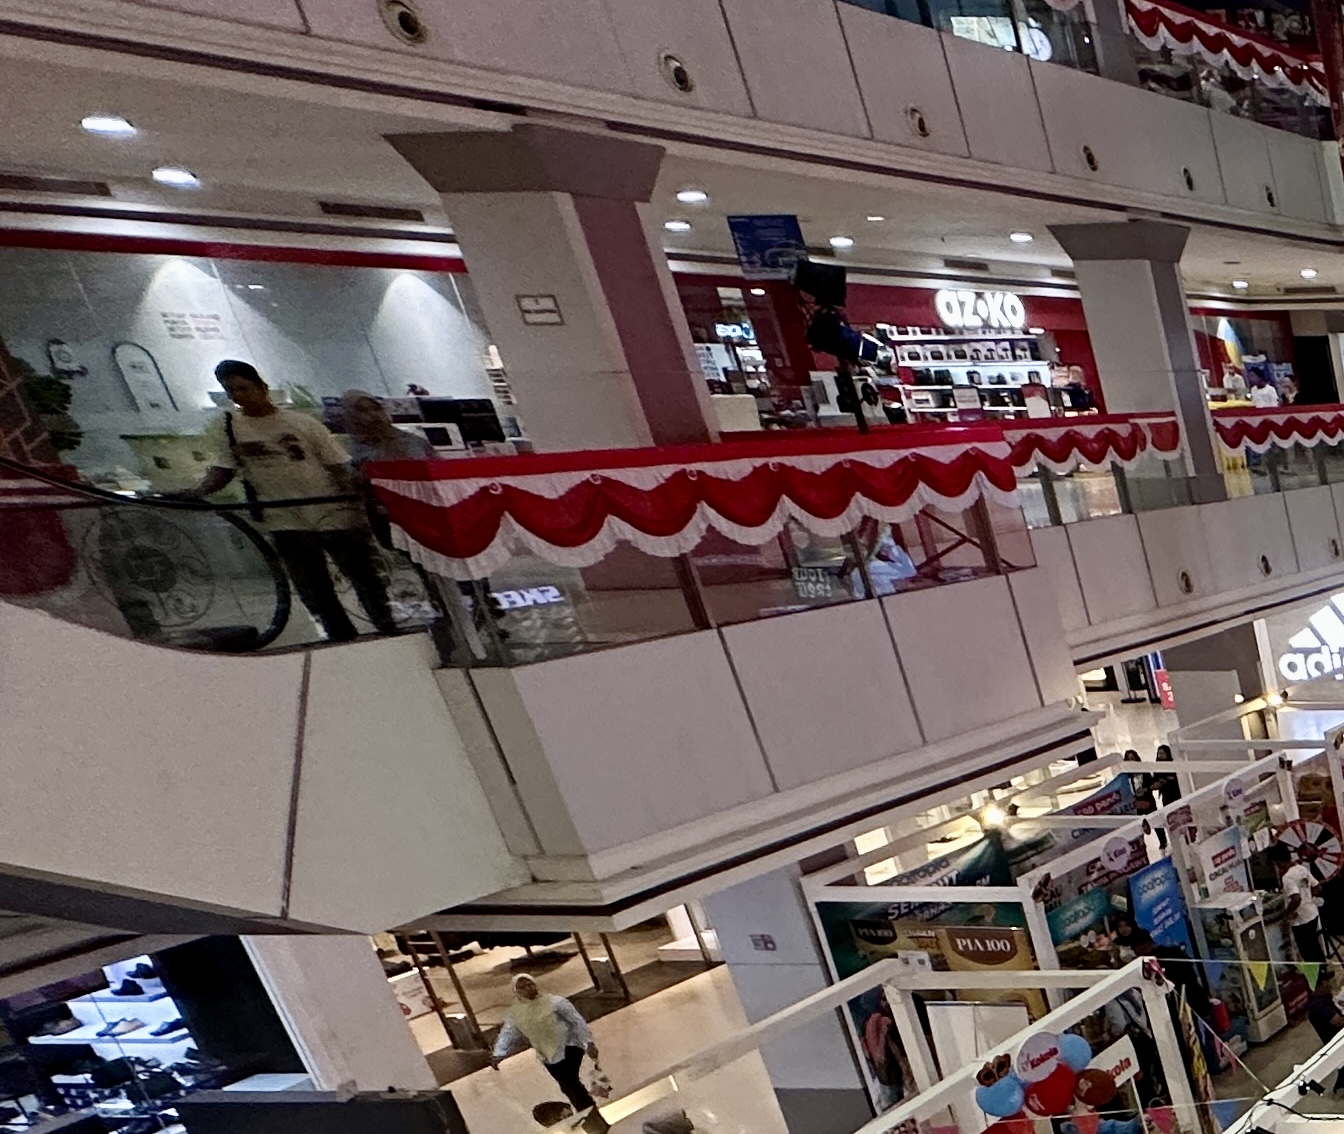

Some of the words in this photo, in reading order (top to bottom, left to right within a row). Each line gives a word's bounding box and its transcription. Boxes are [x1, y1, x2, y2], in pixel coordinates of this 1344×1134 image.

[956, 938, 983, 952] PIA
[986, 938, 1011, 952] 100
[1030, 1047, 1059, 1069] Kokola
